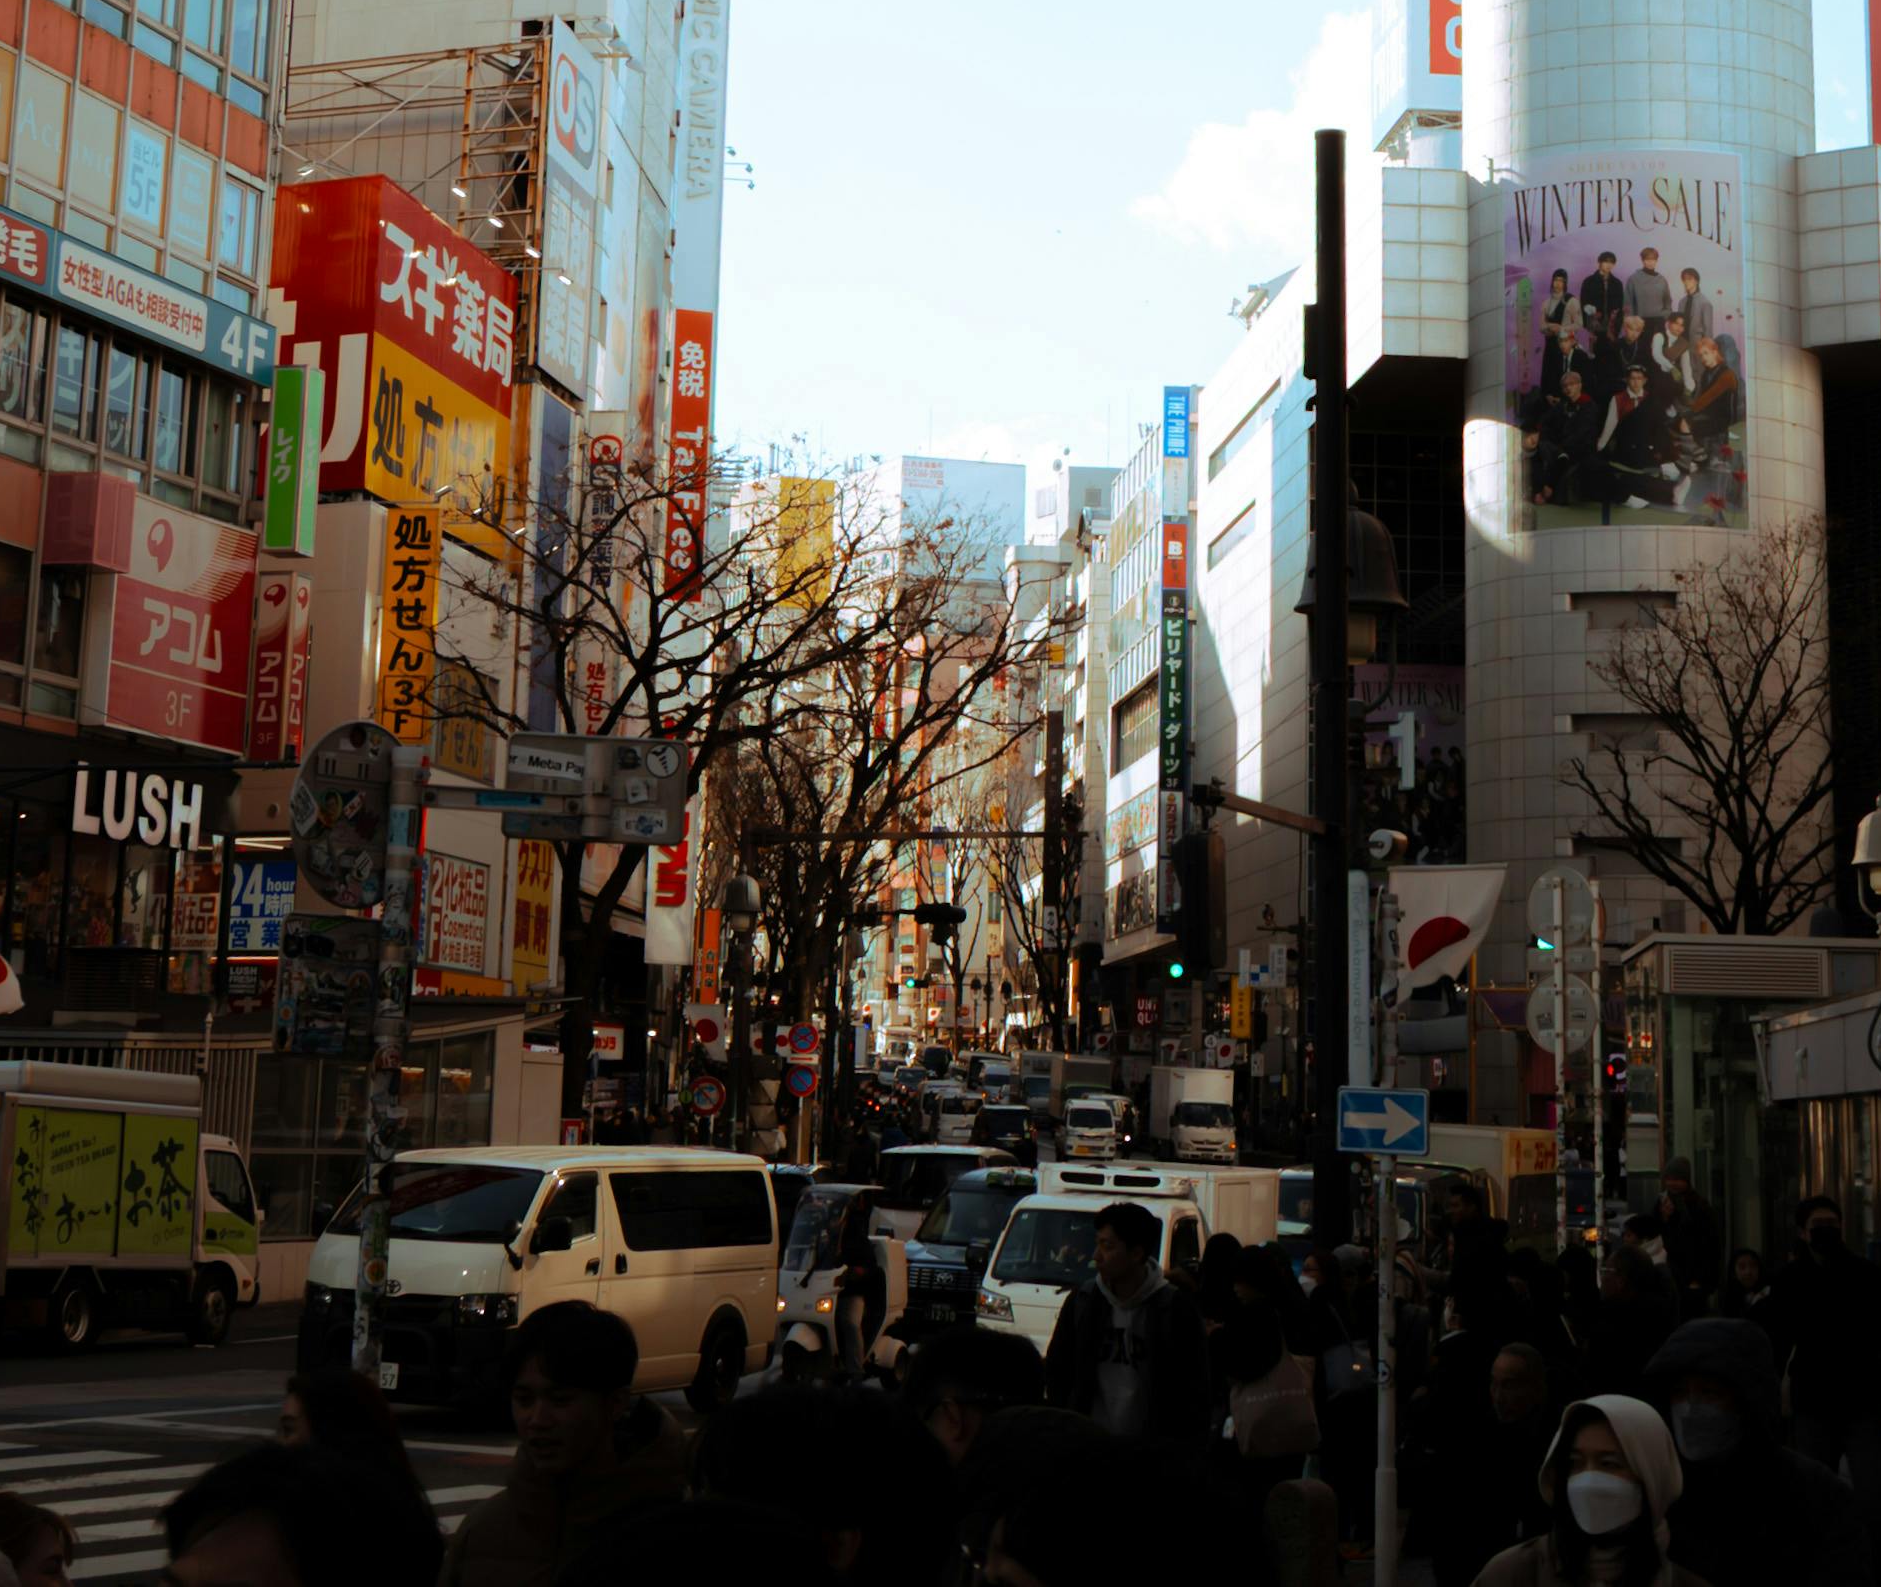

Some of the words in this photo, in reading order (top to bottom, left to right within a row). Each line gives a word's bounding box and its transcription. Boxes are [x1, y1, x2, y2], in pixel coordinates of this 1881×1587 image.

[686, 53, 717, 201] CAMERA
[127, 163, 160, 217] 5F
[1513, 177, 1654, 258] WINTER
[1652, 176, 1734, 252] SALE
[379, 222, 514, 389] スギ薬局
[219, 314, 270, 369] 4F
[678, 340, 706, 397] 免税
[271, 427, 292, 485] レイク
[388, 515, 432, 673] 処方せん
[139, 597, 223, 675] アコム
[165, 689, 191, 729] 3F
[256, 651, 283, 724] アコム
[71, 761, 204, 853] LUSH
[230, 862, 265, 918] 24
[266, 876, 296, 892] hour
[444, 861, 486, 919] 化粧品
[441, 913, 483, 942] Cosmetics
